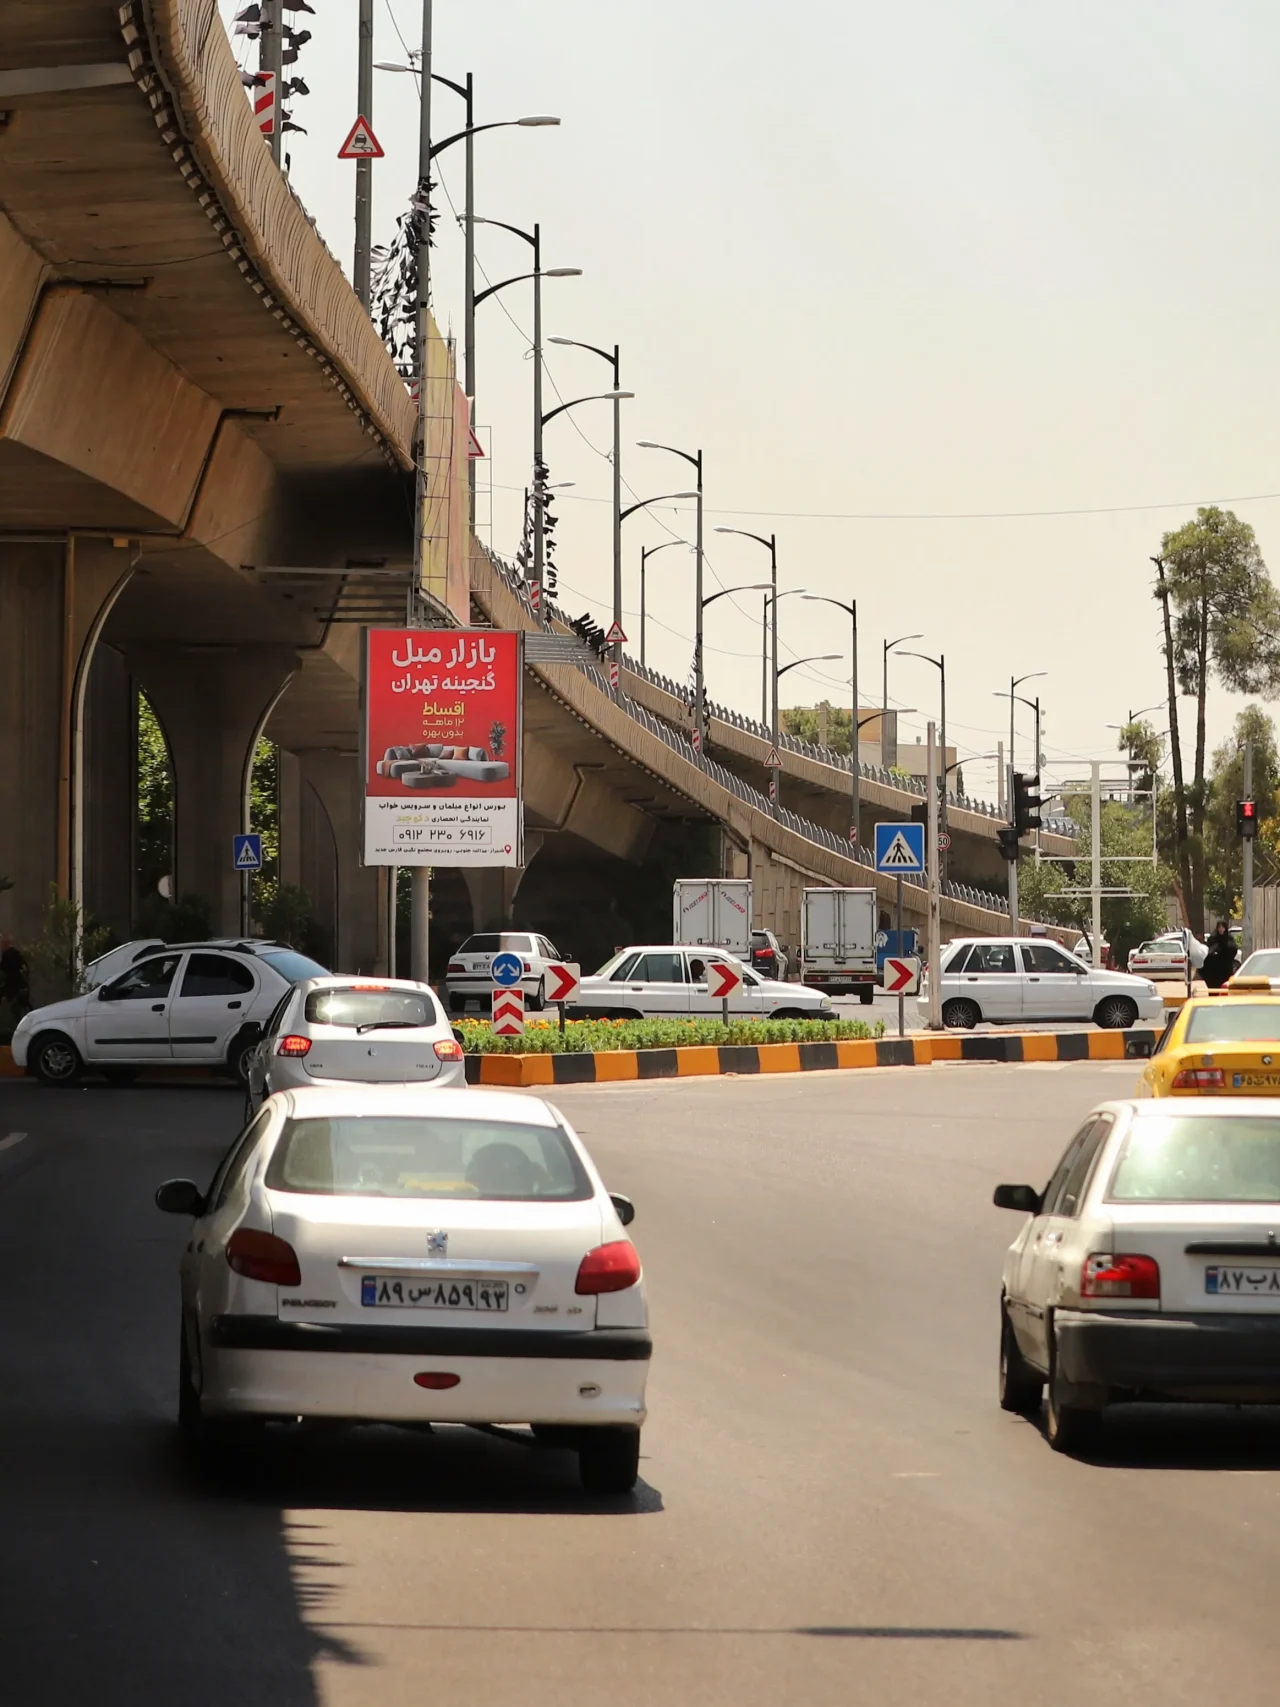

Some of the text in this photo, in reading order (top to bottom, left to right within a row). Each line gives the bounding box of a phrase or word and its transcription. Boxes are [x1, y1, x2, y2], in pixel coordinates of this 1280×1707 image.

[391, 637, 496, 669] بازار مبل
[391, 671, 496, 695] گنجینه تهران
[422, 701, 465, 716] اقساط
[422, 718, 465, 726] ۱۲ ماهه
[422, 729, 464, 739] بدون بهره
[378, 802, 399, 810] خواب
[464, 803, 482, 812] انواع
[460, 815, 489, 823] نمایندگی
[398, 829, 486, 841] ۰۹۱۲ ۲۳۰ ۶۹۱۶
